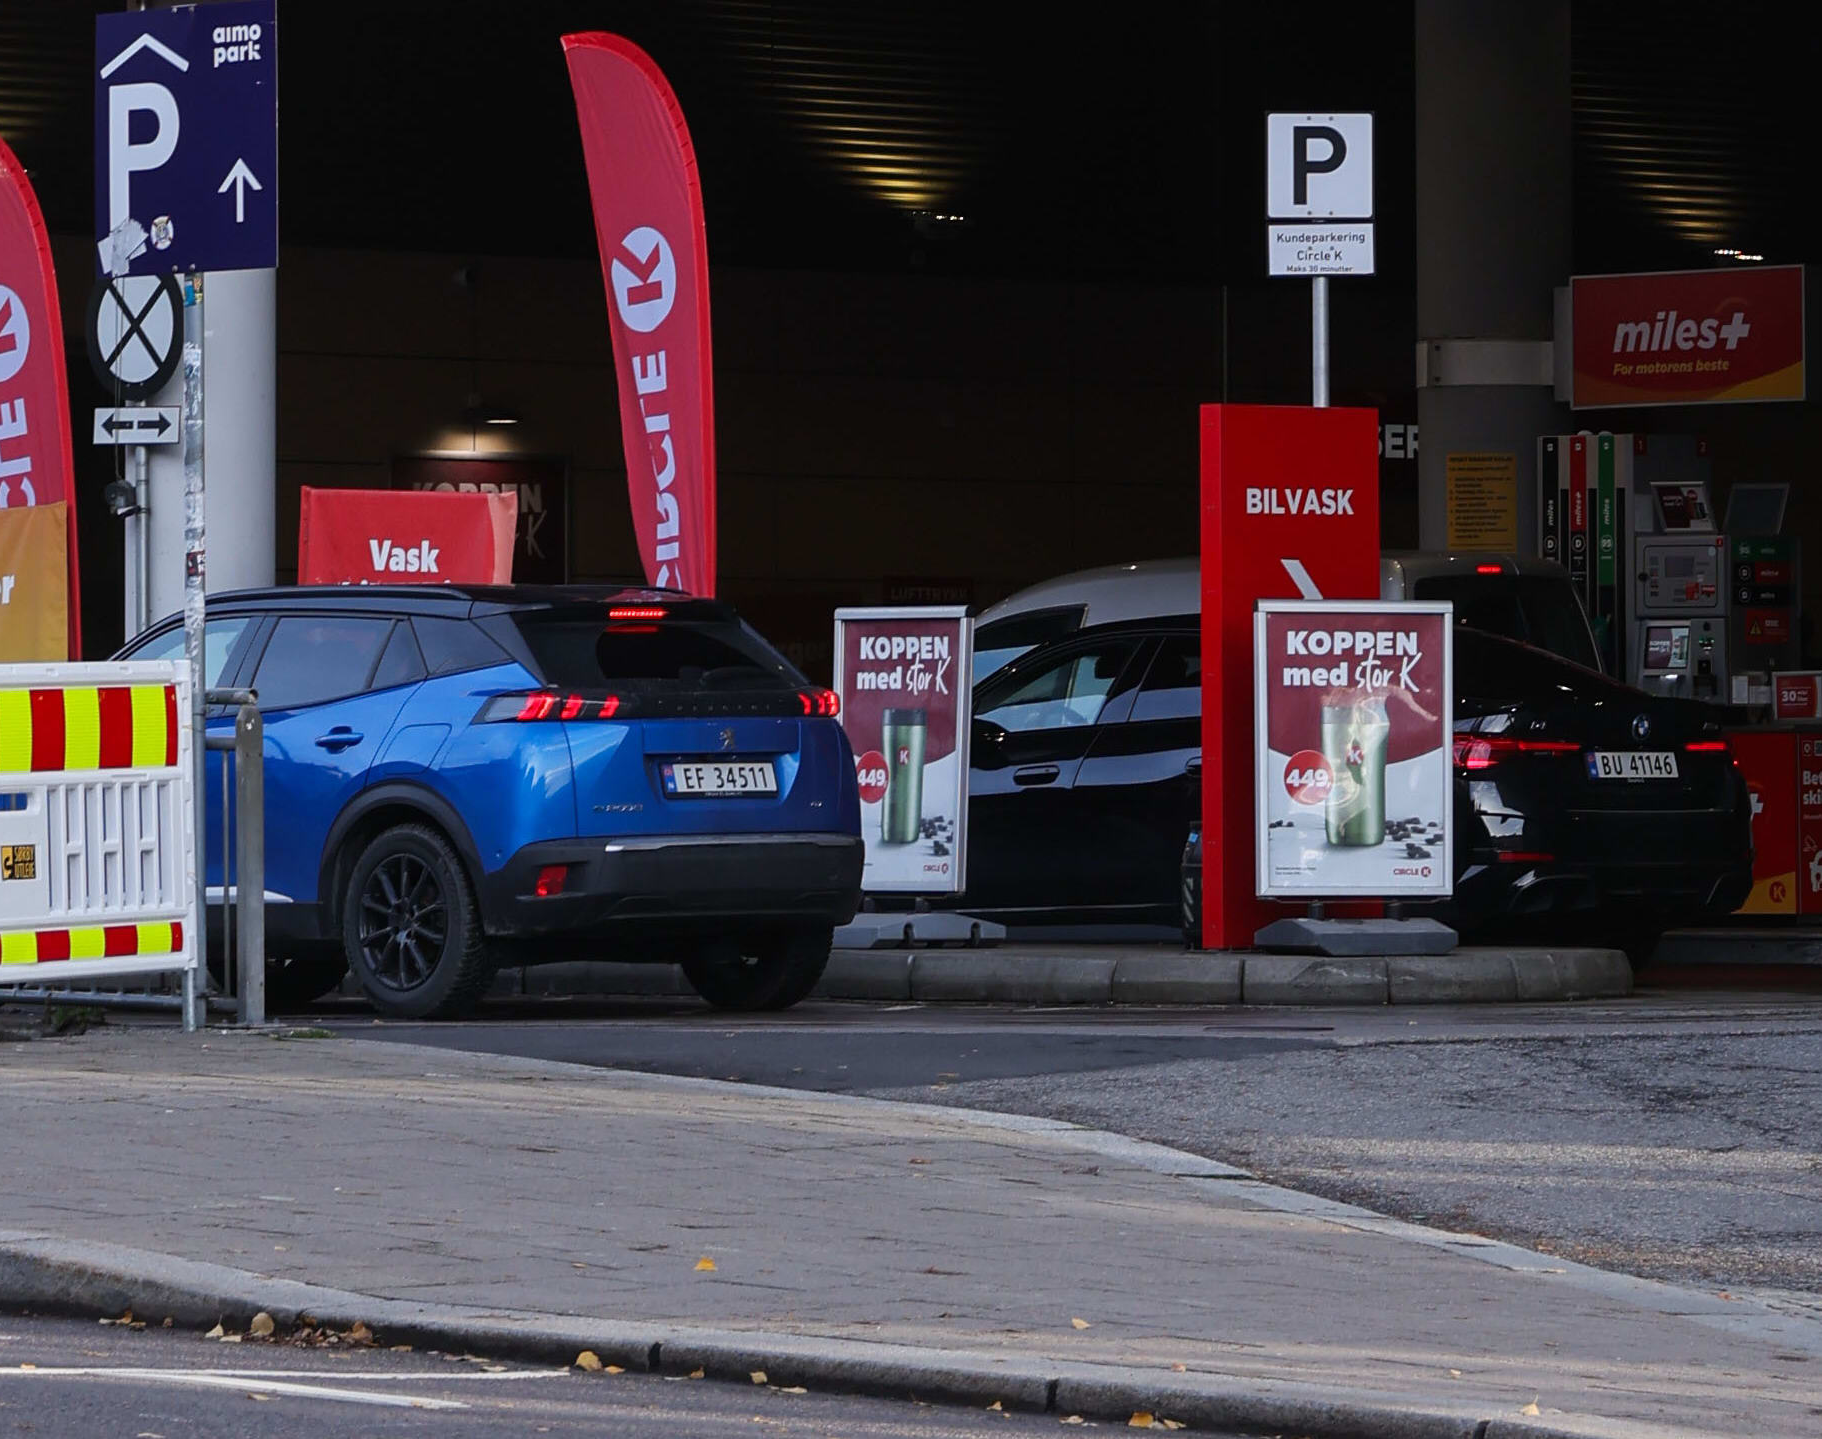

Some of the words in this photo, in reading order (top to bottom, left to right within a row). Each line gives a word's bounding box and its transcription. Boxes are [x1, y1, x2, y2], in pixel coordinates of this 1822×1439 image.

[212, 23, 262, 44] aimo
[213, 41, 262, 69] park
[108, 81, 180, 244] P
[1293, 125, 1347, 206] P
[1276, 232, 1366, 244] Kundeparkering
[1296, 250, 1331, 261] Circle
[1334, 250, 1343, 261] K
[1286, 265, 1307, 273] Maks
[1308, 265, 1319, 273] 30
[1320, 265, 1354, 273] minutter
[1611, 310, 1752, 353] miles+
[1612, 362, 1633, 377] For
[1635, 361, 1694, 375] motorens
[1695, 359, 1730, 372] beste
[1245, 487, 1355, 516] BILVASK
[368, 538, 441, 574] Vask
[859, 635, 949, 660] KOPPEN
[1286, 630, 1418, 656] KOPPEN
[856, 665, 903, 691] med
[906, 653, 933, 696] stor
[935, 655, 952, 695] K
[1282, 661, 1348, 687] med
[1354, 648, 1395, 693] stor
[1399, 651, 1423, 693] K
[1601, 754, 1623, 776] BU
[1630, 754, 1673, 776] 41146
[683, 767, 706, 790] EF
[715, 766, 769, 790] 34511
[1393, 867, 1420, 876] CIRCLE
